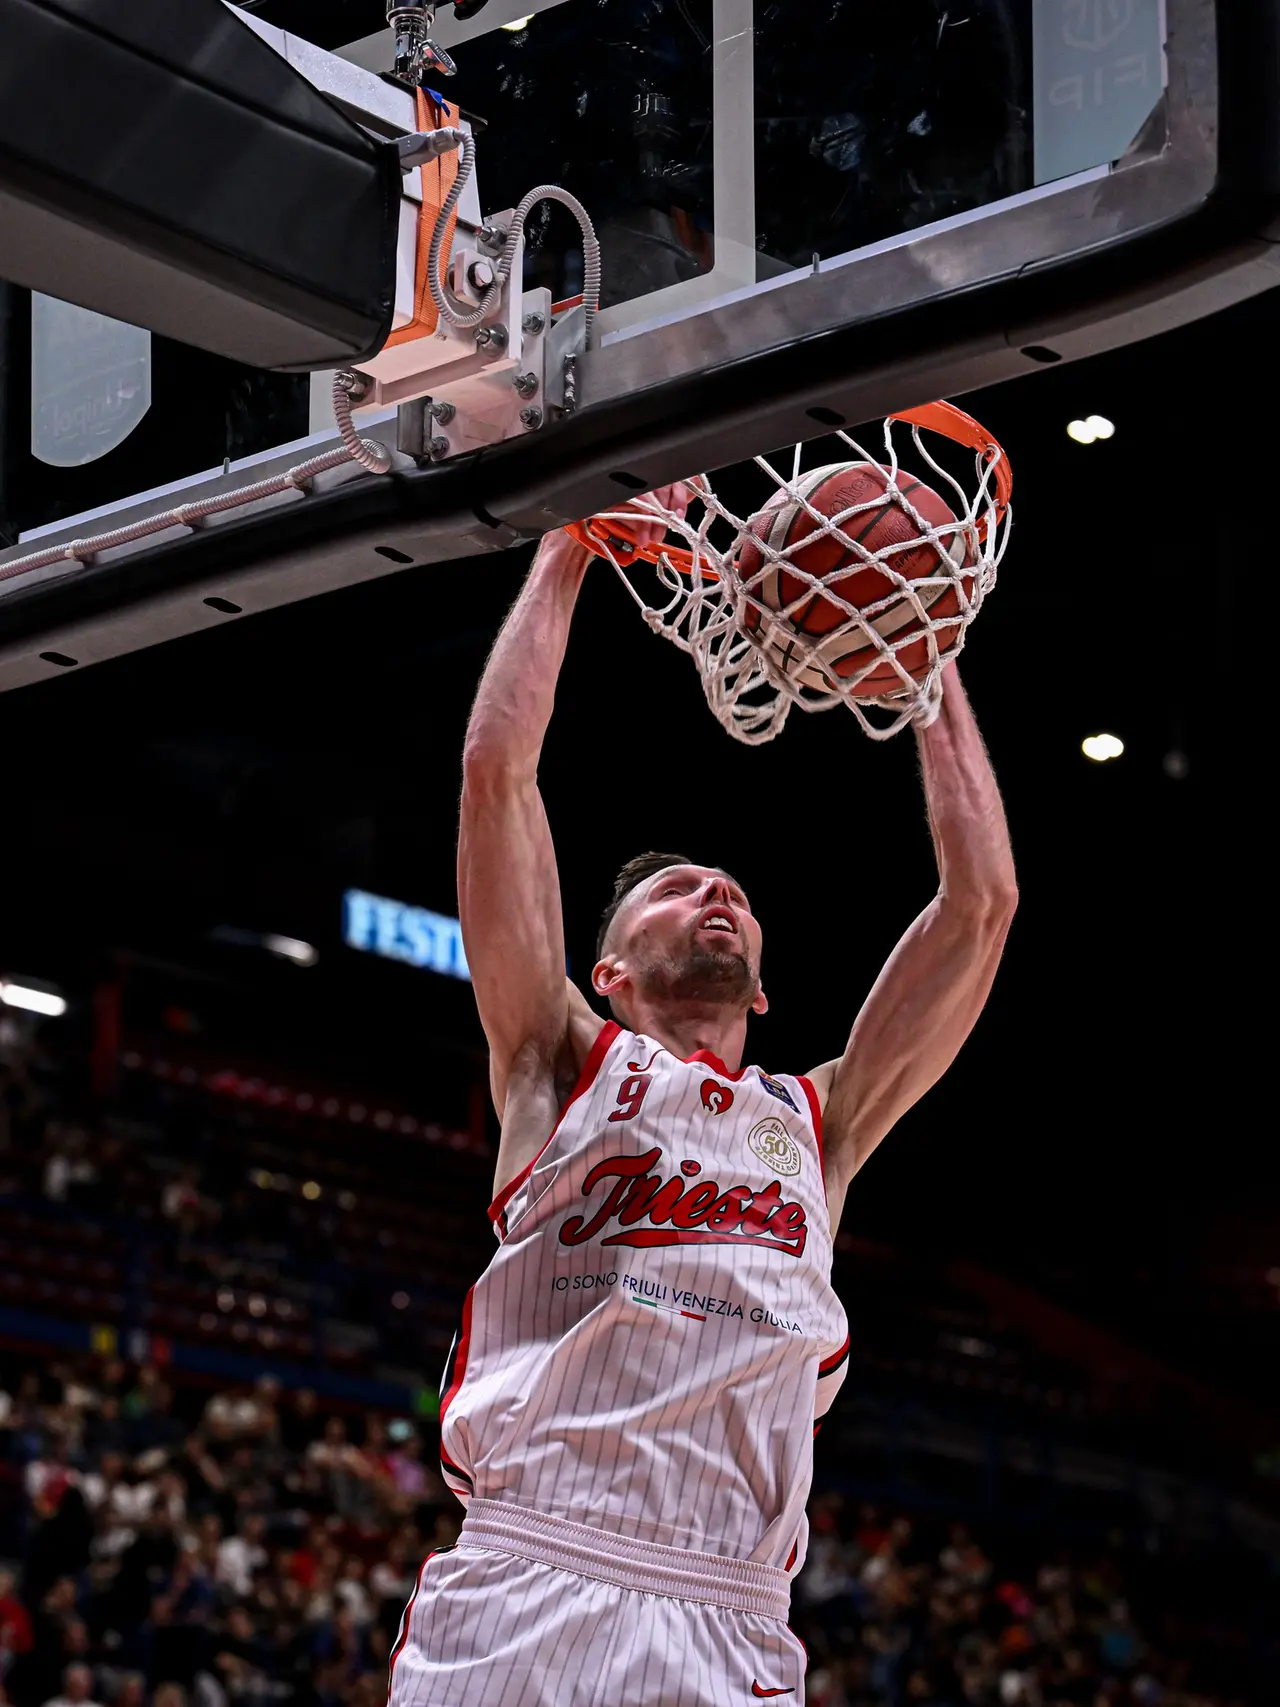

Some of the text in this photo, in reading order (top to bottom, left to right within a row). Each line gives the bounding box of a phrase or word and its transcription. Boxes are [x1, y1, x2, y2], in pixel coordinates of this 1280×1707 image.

[607, 1074, 653, 1122] 9
[762, 1135, 788, 1156] 50
[558, 1146, 808, 1257] Trieste
[551, 1271, 803, 1334] IO SONO FRIULI VENEZIA GIULIA
